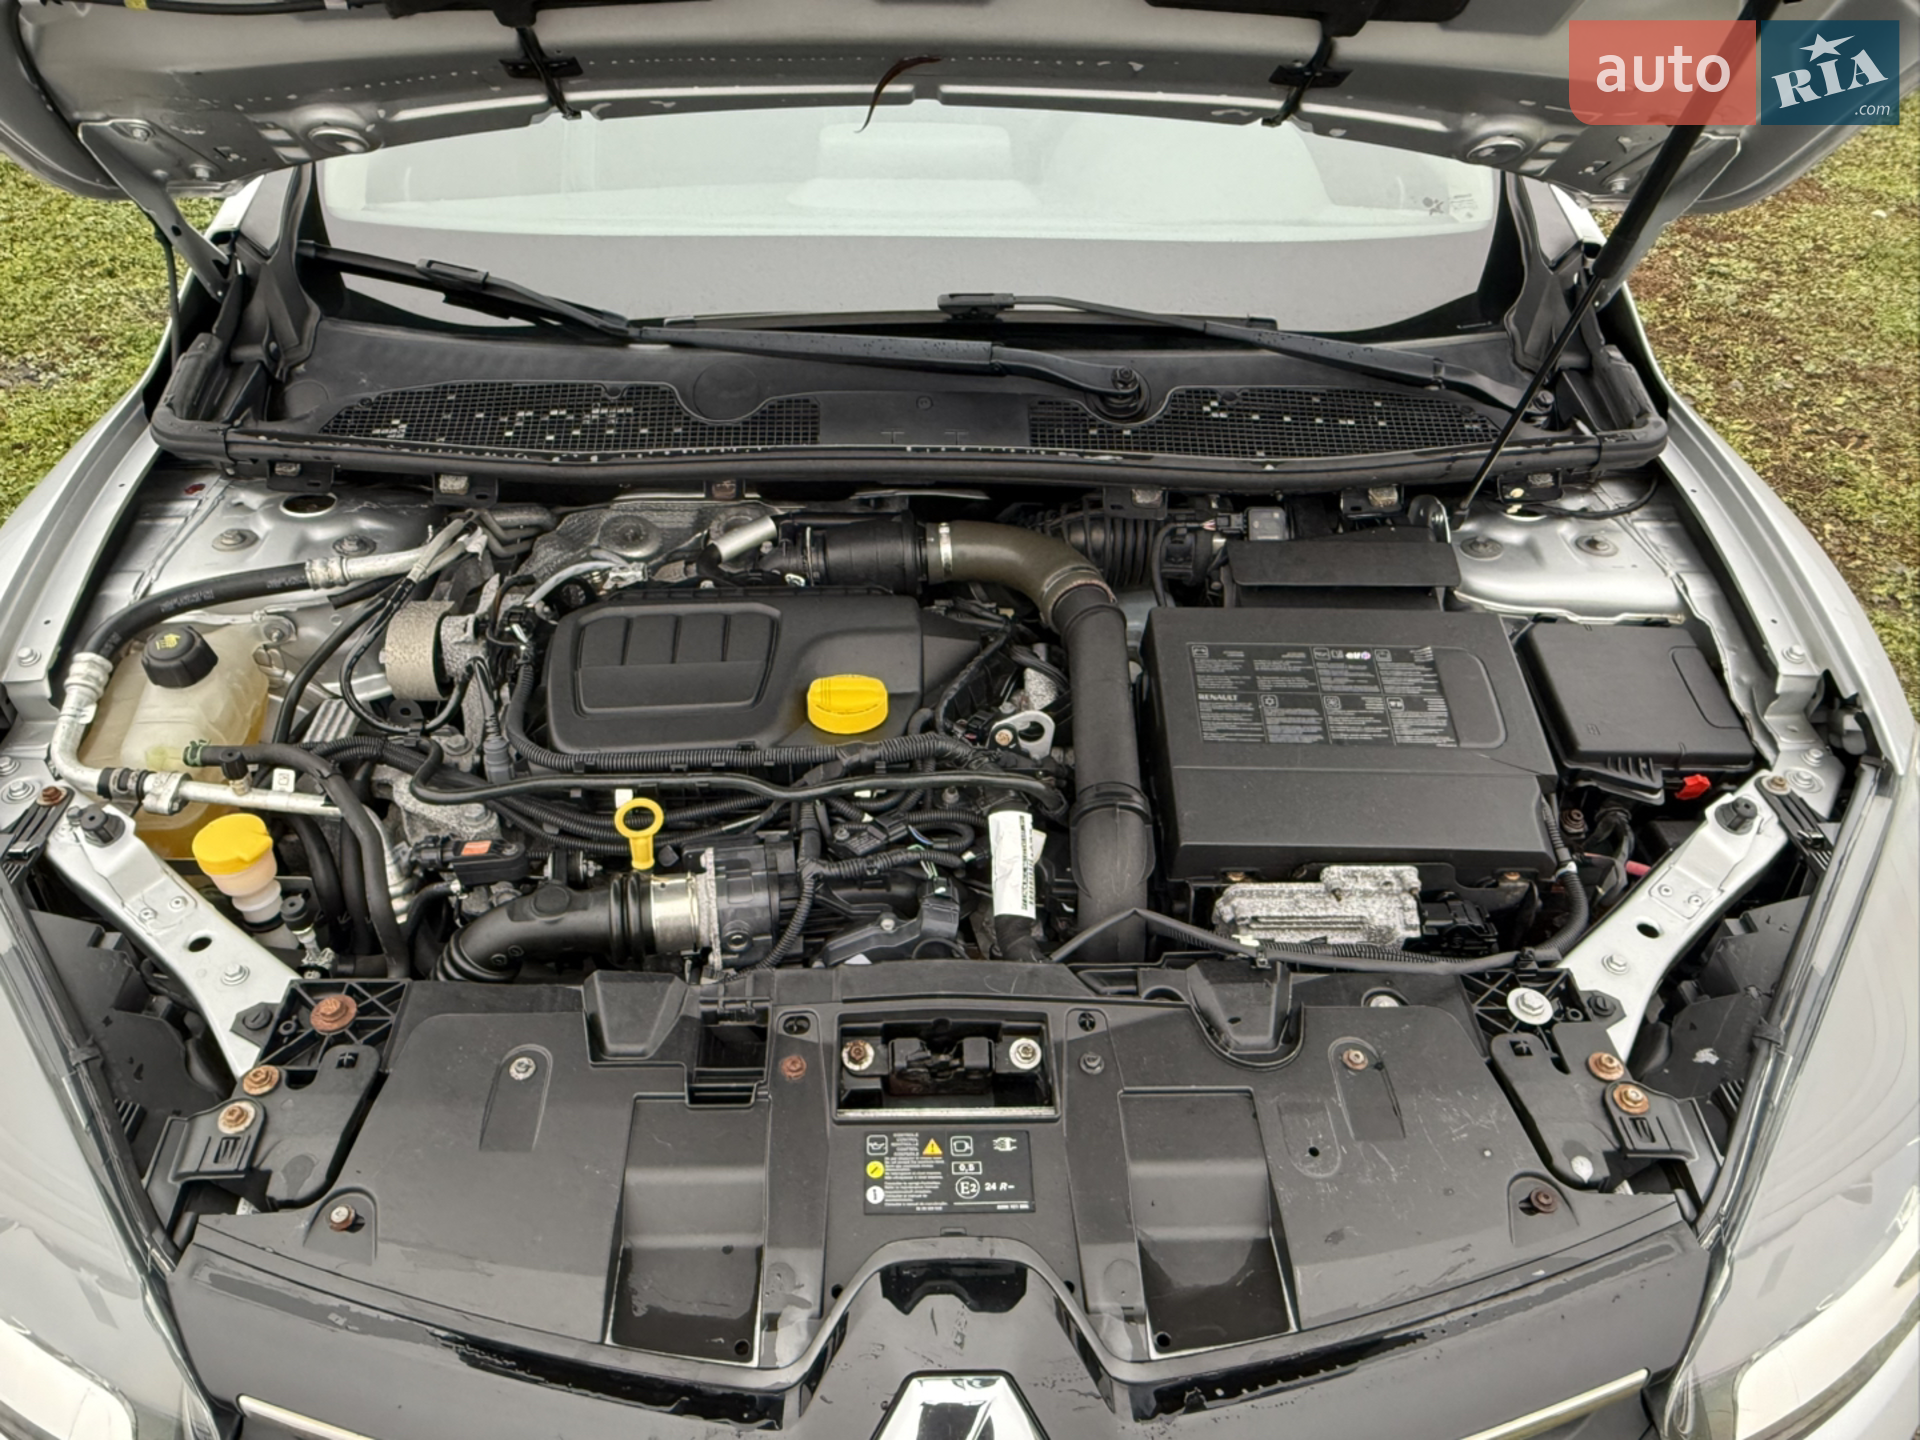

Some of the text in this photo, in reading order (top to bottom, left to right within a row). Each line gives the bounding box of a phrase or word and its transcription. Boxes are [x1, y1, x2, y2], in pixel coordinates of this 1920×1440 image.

[1197, 693, 1238, 701] RENAULT
[959, 1181, 978, 1195] E2
[984, 1182, 997, 1191] 24
